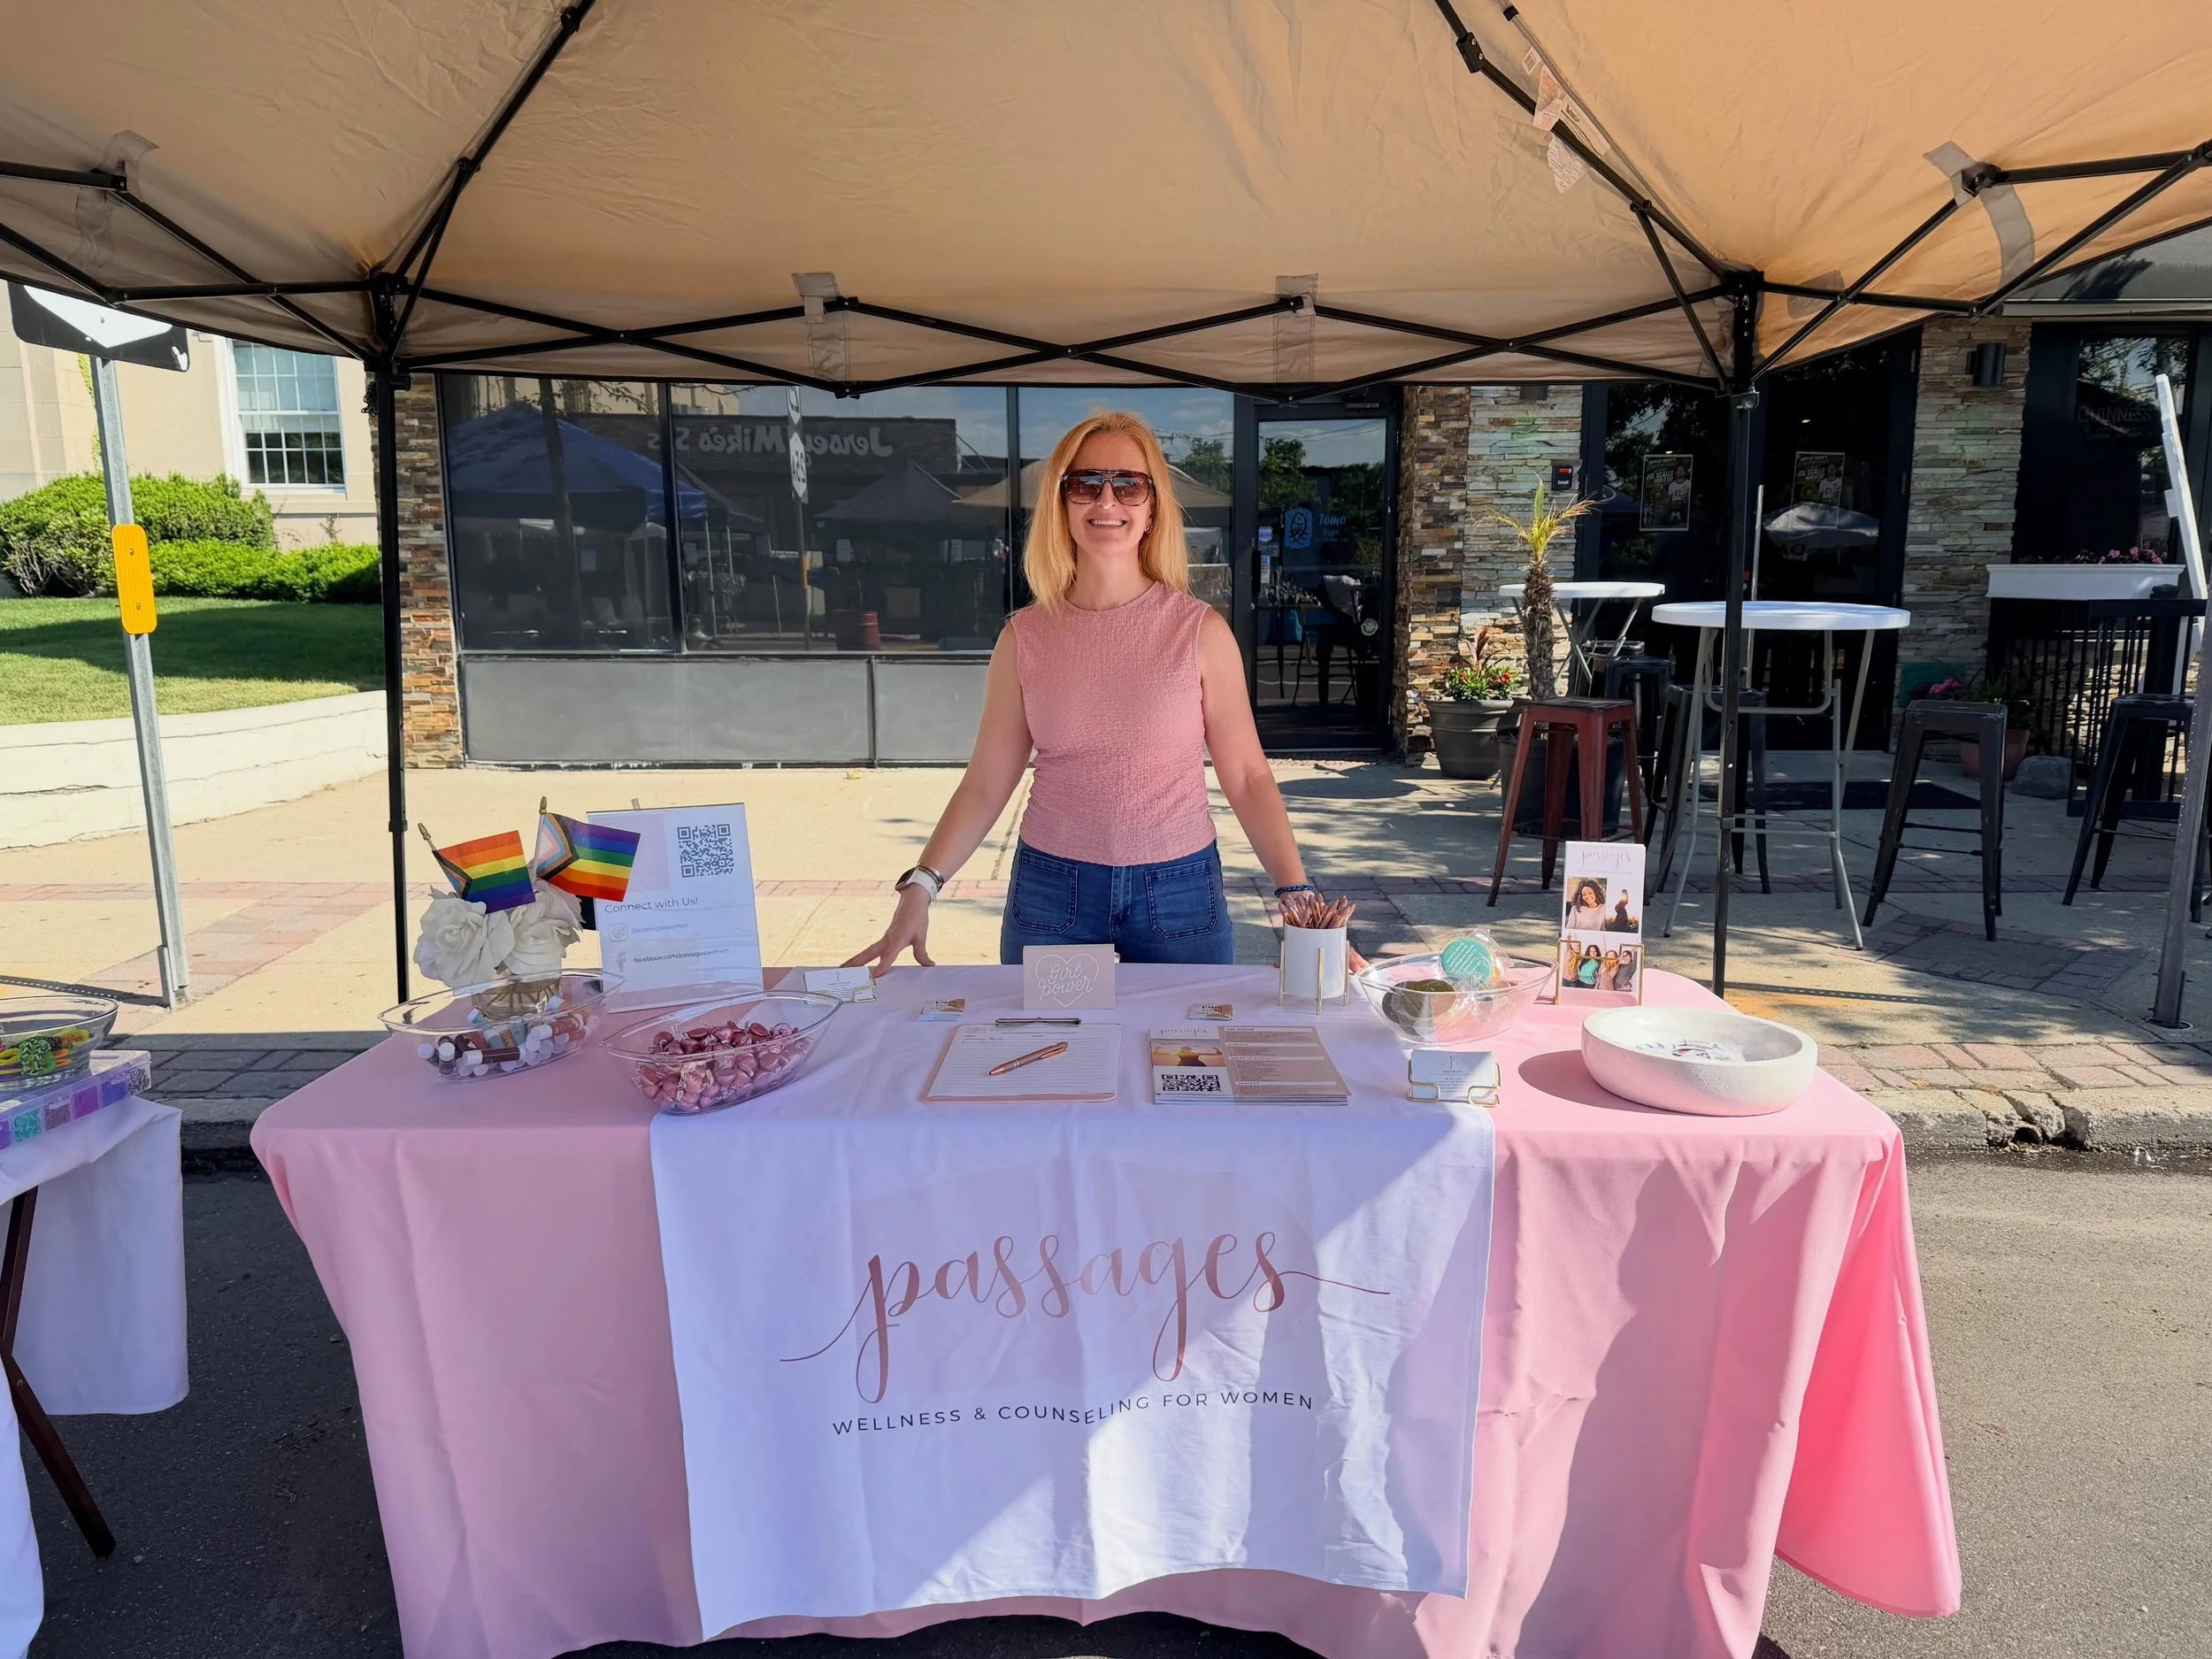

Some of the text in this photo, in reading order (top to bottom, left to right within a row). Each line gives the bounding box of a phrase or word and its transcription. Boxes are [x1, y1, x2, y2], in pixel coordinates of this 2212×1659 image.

[604, 896, 699, 913] Connect with Us!
[631, 923, 689, 934] @passageswomen
[634, 948, 729, 964] facebook.com/passageswomen
[1048, 961, 1082, 984] Girl
[1038, 975, 1093, 1002] power
[780, 1232, 1390, 1403] passages
[833, 1391, 1313, 1435] WELLNESS & COUNSELING FOR WOMEN
